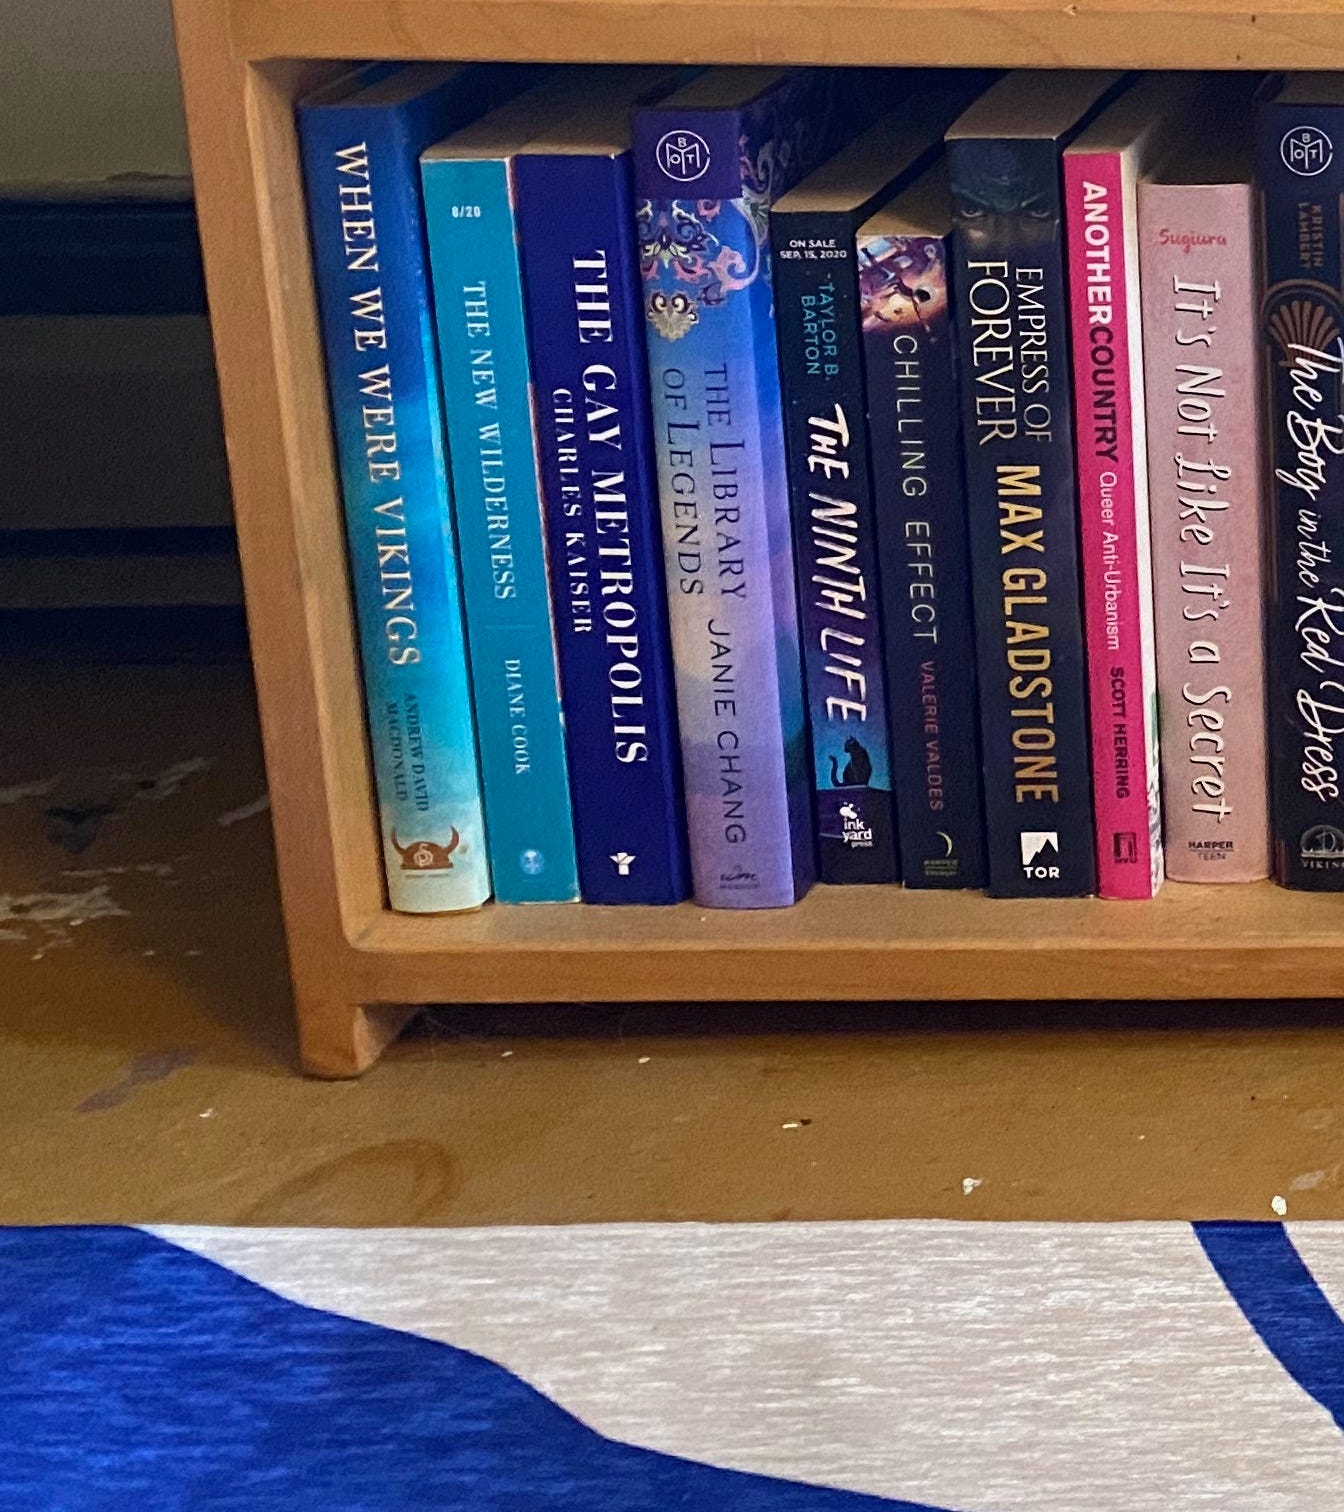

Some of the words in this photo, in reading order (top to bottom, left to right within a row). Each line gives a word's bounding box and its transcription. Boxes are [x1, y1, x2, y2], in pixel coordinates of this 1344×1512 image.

[335, 141, 380, 272] WHEN
[789, 239, 805, 249] ON
[807, 239, 836, 249] SALE
[349, 287, 385, 351] WE
[572, 249, 614, 344] THE
[1015, 267, 1050, 394] EMPRESS
[1173, 275, 1222, 348] It's
[967, 259, 1018, 445] FOREVER
[357, 364, 400, 483] WERE
[581, 364, 624, 451] GAY
[1024, 400, 1052, 443] OF
[1175, 363, 1225, 443] Not
[552, 388, 583, 517] CHARLES
[1098, 471, 1114, 525] Queer
[1173, 451, 1232, 545] Like
[996, 464, 1044, 555] MAX
[1297, 509, 1316, 537] in
[372, 497, 421, 667] VIKINGS
[565, 532, 592, 634] KAISER
[1102, 530, 1121, 651] Anti-Urbanism
[1180, 562, 1231, 623] It's
[1298, 543, 1331, 587] the
[590, 471, 649, 764] METROPOLIS
[1187, 640, 1219, 665] a
[708, 619, 736, 717] JANIE
[1001, 567, 1060, 804] GLADSTONE
[1110, 667, 1126, 721] SCOTT
[404, 694, 422, 759] ANDREW
[413, 763, 427, 812] DAVID
[715, 730, 746, 844] CHANG
[1114, 725, 1130, 799] HERRING
[1183, 684, 1233, 824] Secret
[843, 817, 864, 830] ink
[843, 827, 872, 844] yard
[1024, 866, 1060, 878] TOR
